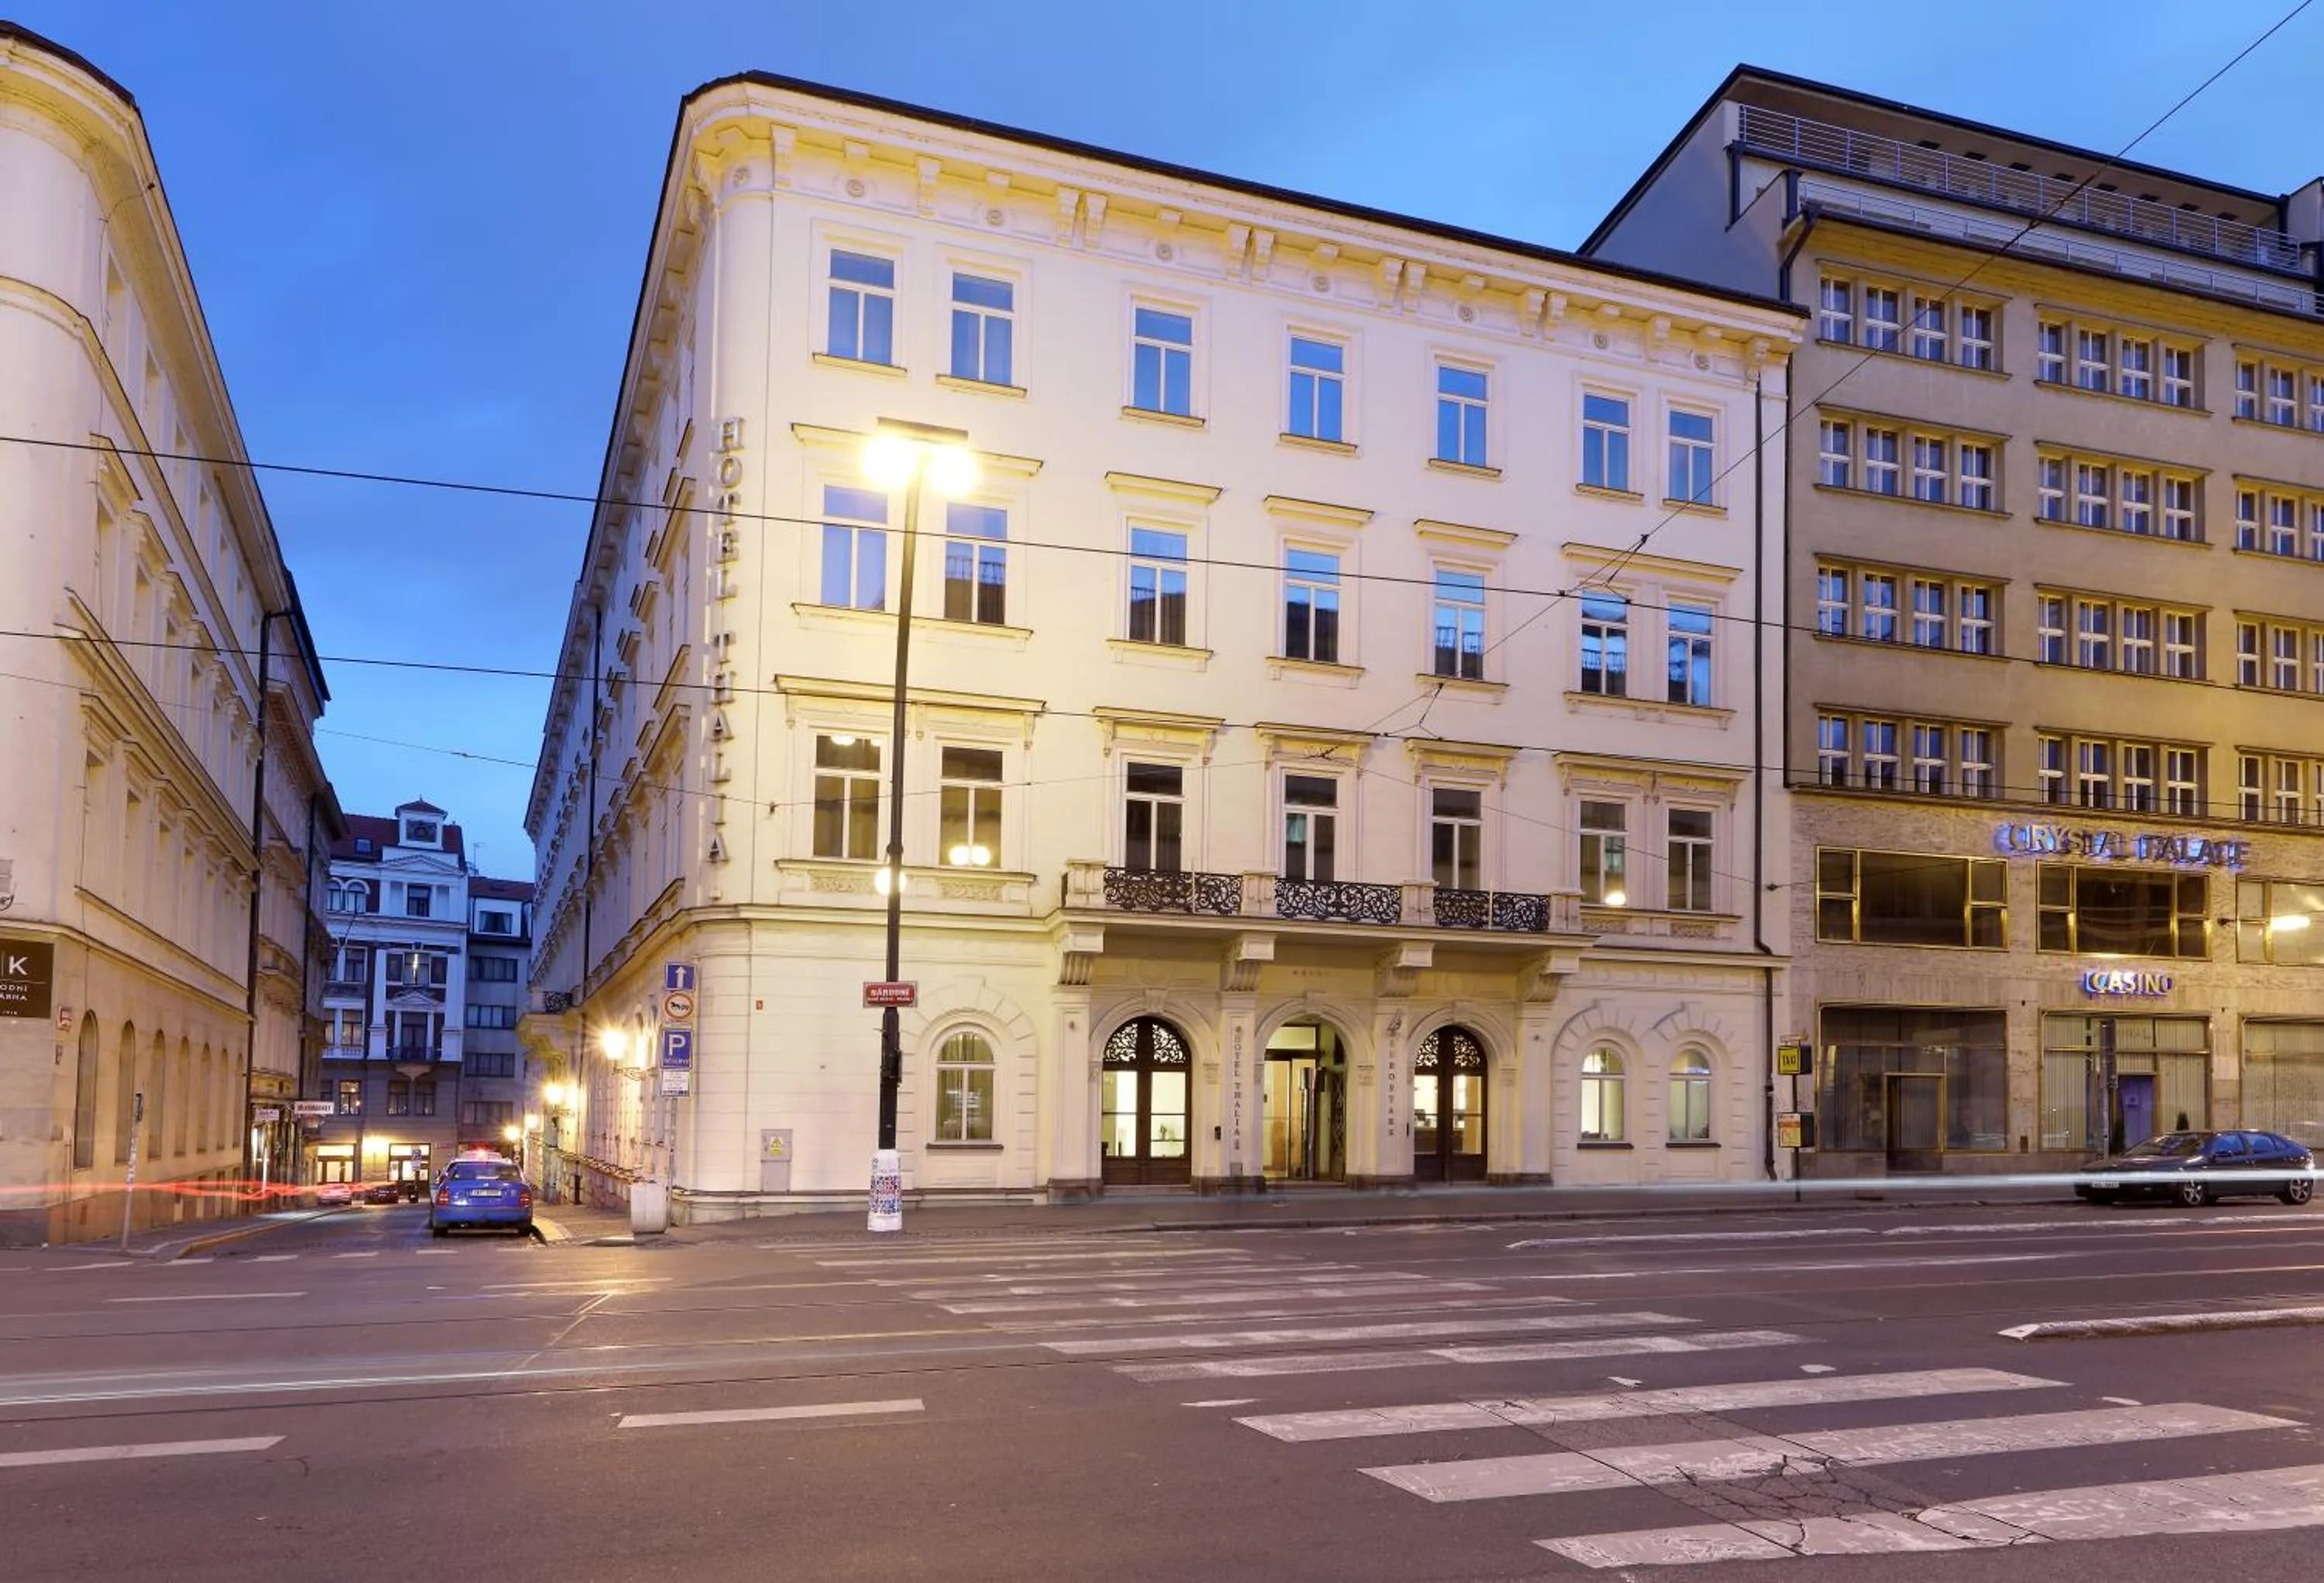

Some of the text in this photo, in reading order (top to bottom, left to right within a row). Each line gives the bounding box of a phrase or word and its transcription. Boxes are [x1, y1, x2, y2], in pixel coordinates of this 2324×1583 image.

[706, 417, 744, 864] HOTEL THALIA
[1995, 822, 2250, 868] CRYSTAL PALACE
[9, 956, 28, 975] K
[2083, 970, 2174, 996] CASINO
[669, 1034, 686, 1056] P
[1783, 1055, 1796, 1066] TAXI
